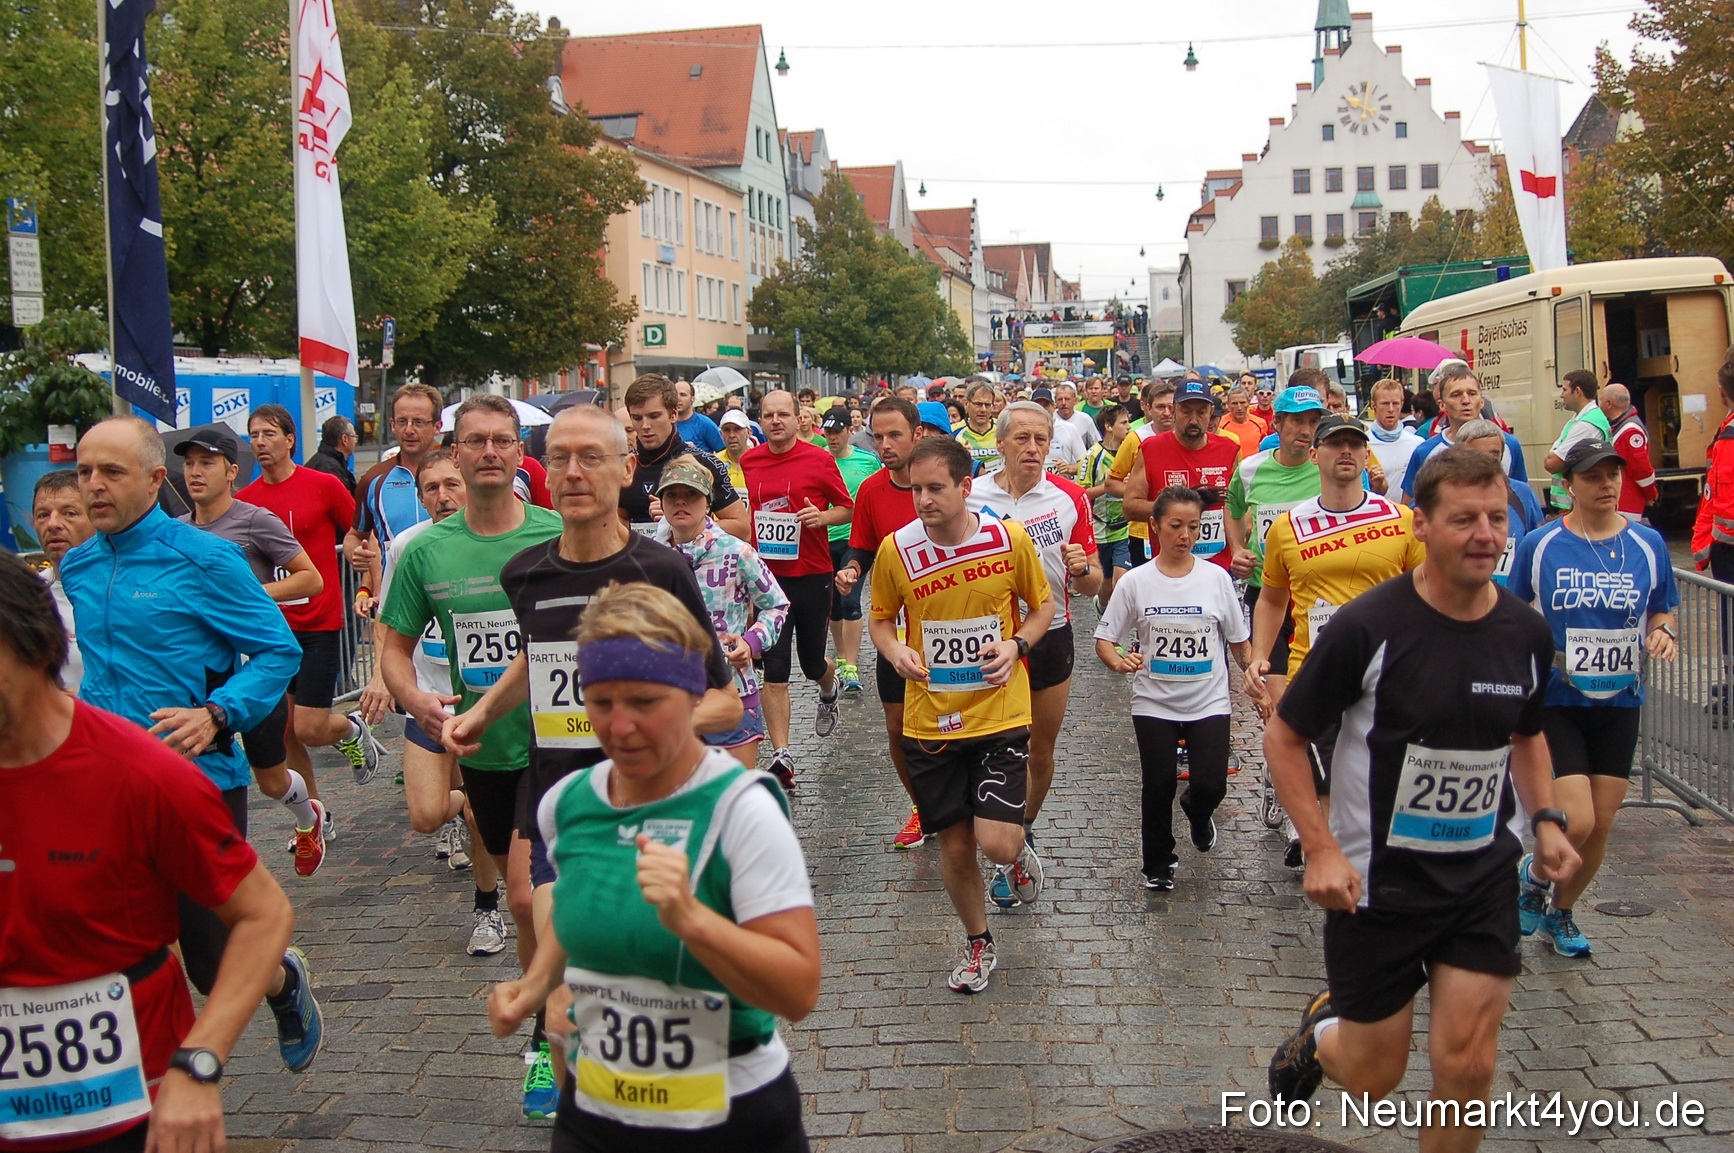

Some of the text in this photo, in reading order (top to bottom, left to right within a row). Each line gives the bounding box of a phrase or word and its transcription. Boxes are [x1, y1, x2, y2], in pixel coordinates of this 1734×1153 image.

[1478, 318, 1528, 346] Bayerisches
[1053, 339, 1083, 349] START
[1478, 348, 1502, 367] Rotes
[1478, 372, 1501, 390] Kreuz
[1024, 508, 1059, 526] memmert
[757, 522, 797, 543] 2302
[759, 544, 790, 555] Johannes
[1300, 524, 1406, 562] MAX BÖGL
[912, 559, 1014, 601] MAX BÖGL
[1556, 568, 1634, 589] Fitness
[1551, 589, 1641, 611] CORNER
[455, 618, 519, 631] PARTL Neuma
[924, 627, 949, 637] PARTL
[951, 624, 988, 636] Neumarkt
[1151, 625, 1203, 636] PARTL Neumarkt
[1155, 636, 1209, 659] 2434
[1568, 635, 1629, 644] PARTL Neumarkt
[531, 653, 561, 664] PARTL
[1574, 646, 1634, 673] 2404
[949, 670, 983, 682] Stefan
[1168, 663, 1195, 674] Maika
[1590, 676, 1617, 690] Sindy
[567, 718, 599, 733] Sko
[1407, 755, 1497, 772] PARTL Neumarkt
[1408, 772, 1499, 814] 2528
[1430, 822, 1471, 838] Claus
[23, 990, 101, 1016] Neumarkt
[569, 983, 697, 1010] PARTL Neumarkt
[0, 1010, 122, 1081] 2583
[600, 1006, 695, 1070] 305
[10, 1085, 113, 1116] Wolfgang
[614, 1079, 669, 1104] Karin
